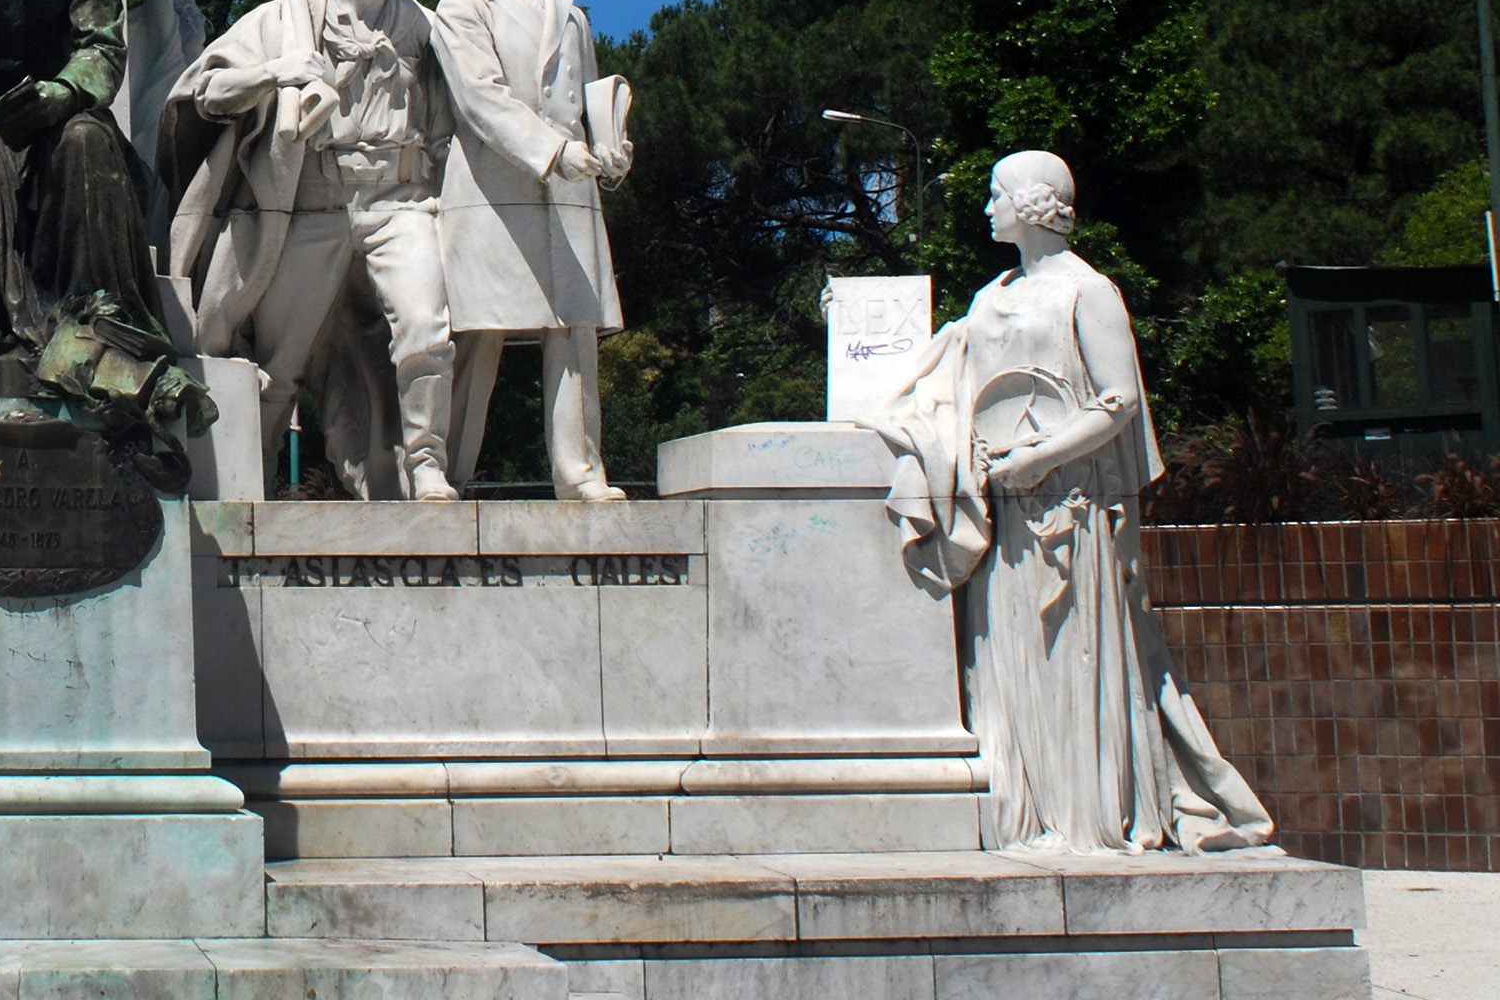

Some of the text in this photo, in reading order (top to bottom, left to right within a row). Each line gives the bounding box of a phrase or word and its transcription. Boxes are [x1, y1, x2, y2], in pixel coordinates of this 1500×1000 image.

[833, 298, 925, 335] LEX
[17, 450, 31, 470] A
[51, 487, 125, 511] VARELA
[332, 556, 394, 587] LAS
[400, 555, 523, 587] CLAES
